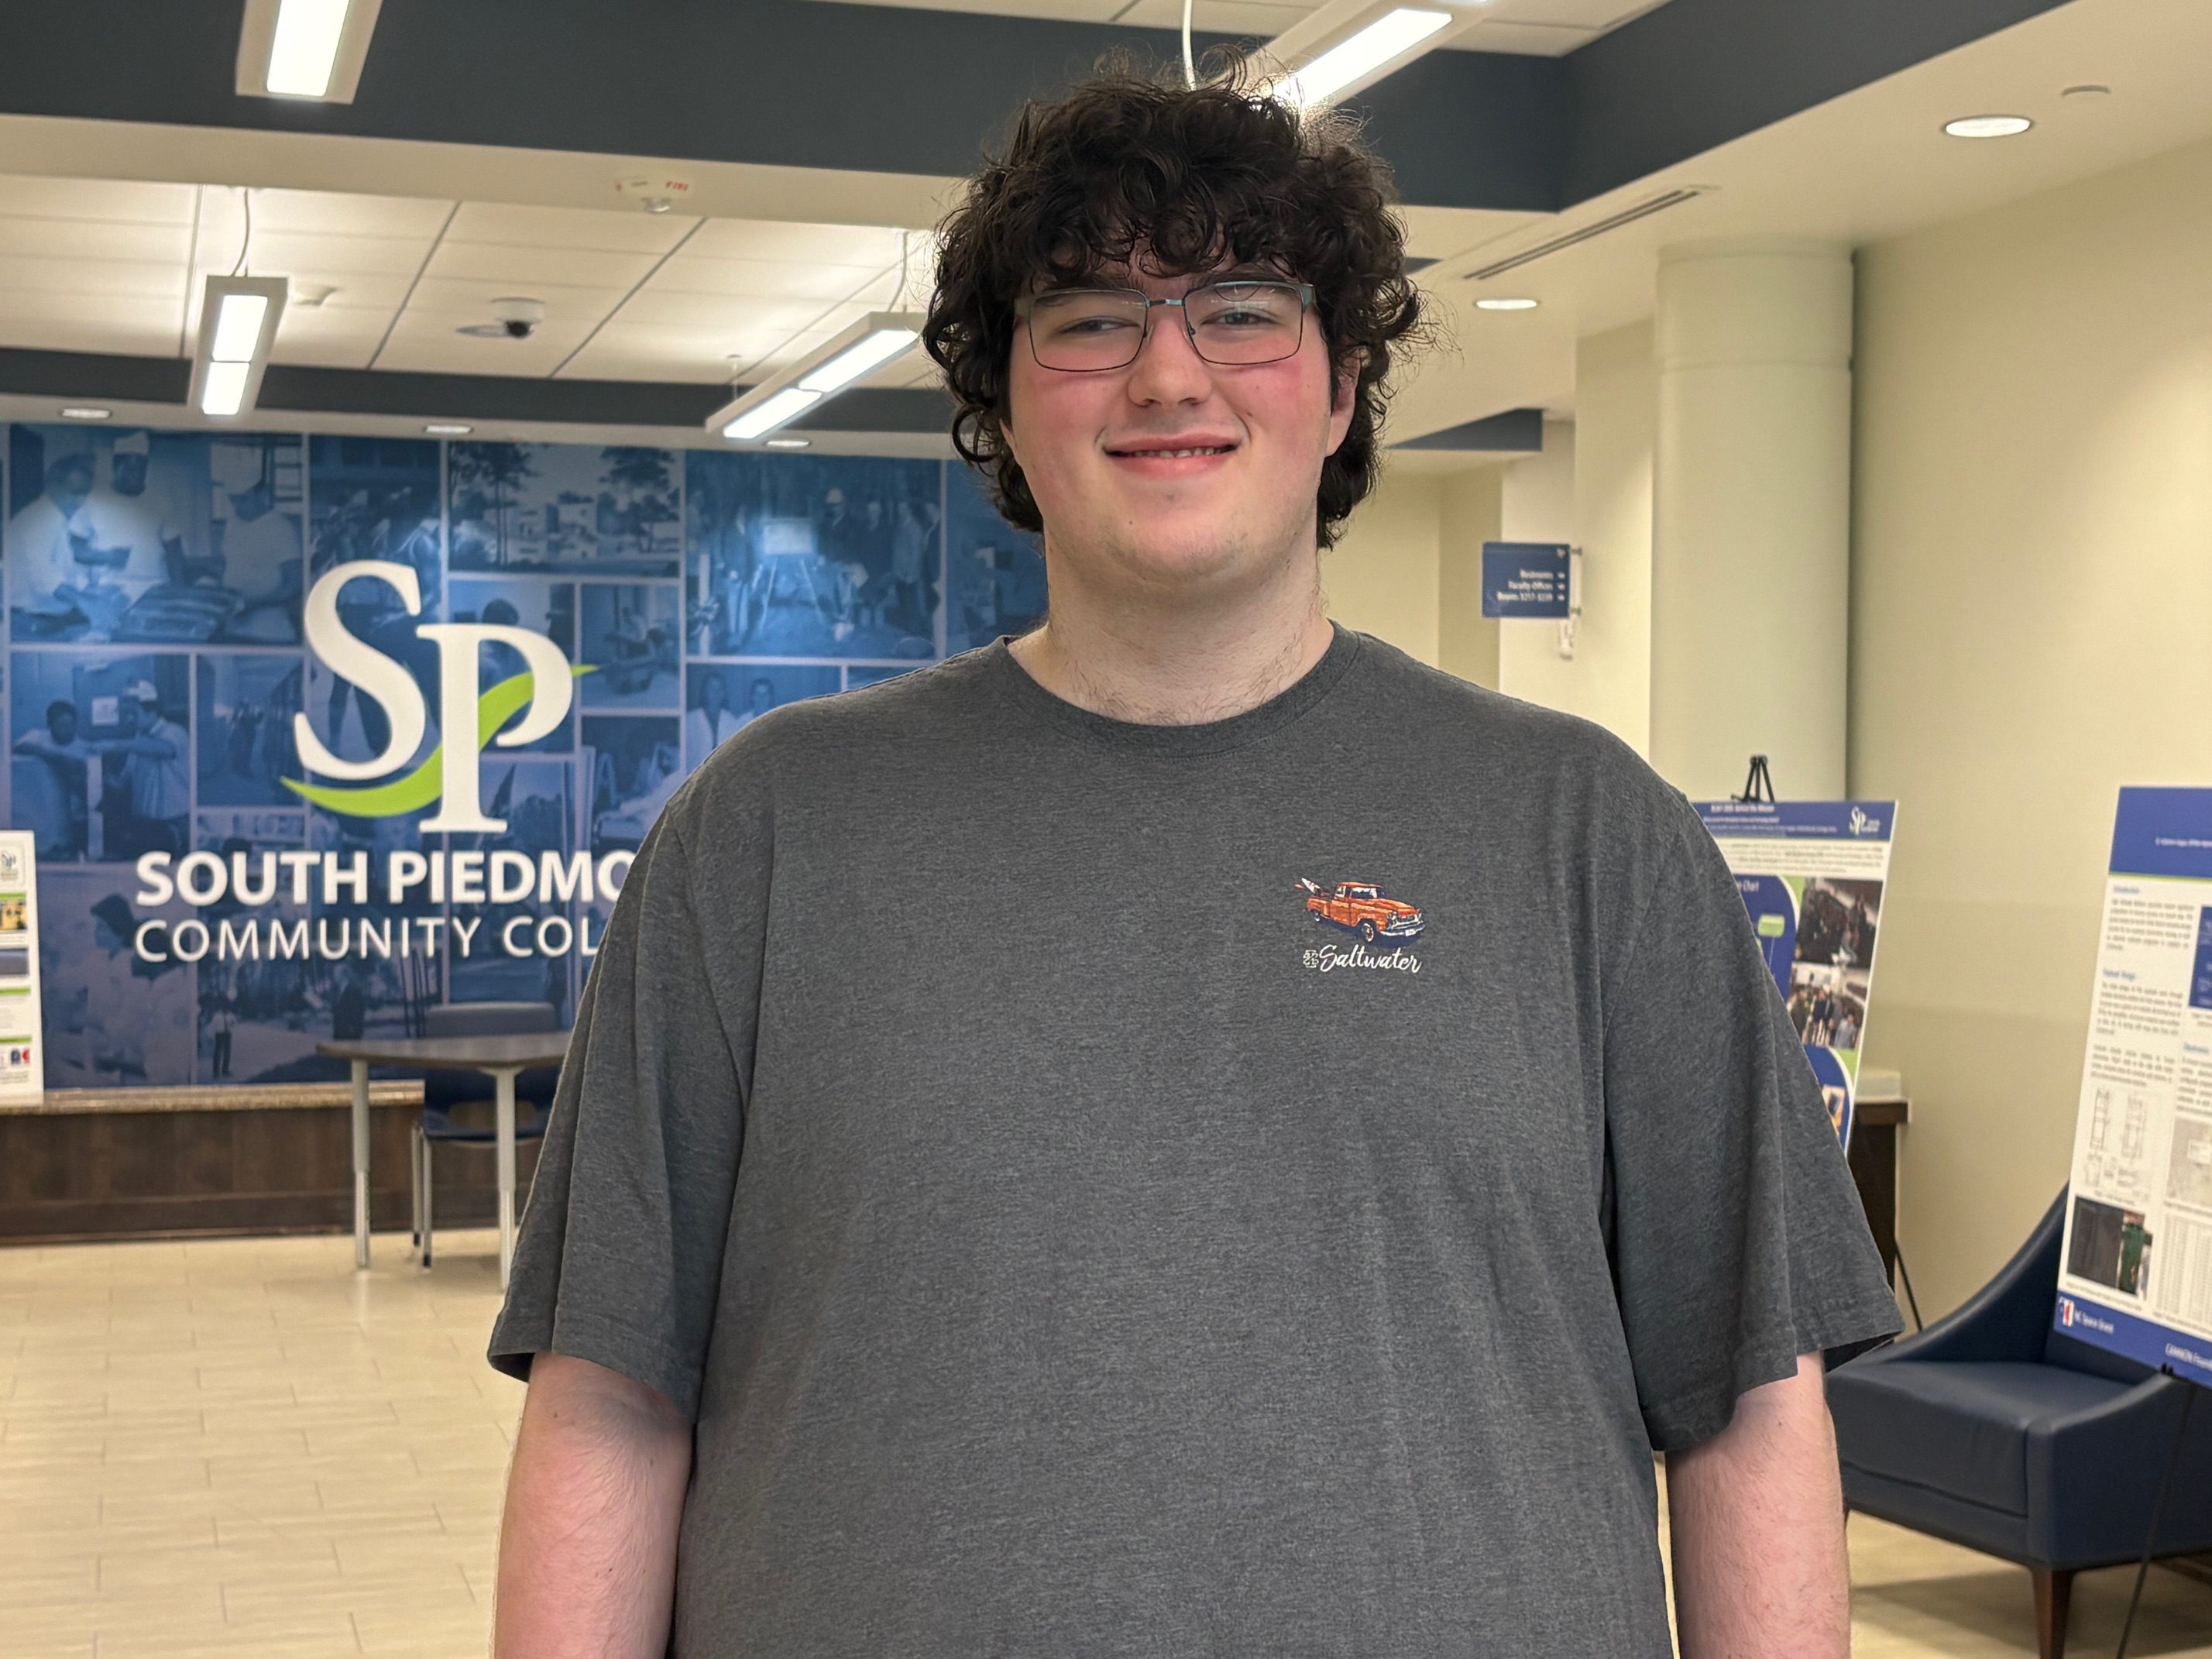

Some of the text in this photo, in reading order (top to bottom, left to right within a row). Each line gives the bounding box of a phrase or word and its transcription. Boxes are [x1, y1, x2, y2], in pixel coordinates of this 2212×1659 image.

[136, 850, 368, 906] SOUTH
[135, 917, 482, 963] COMMUNITY
[1319, 944, 1422, 973] Saltwater
